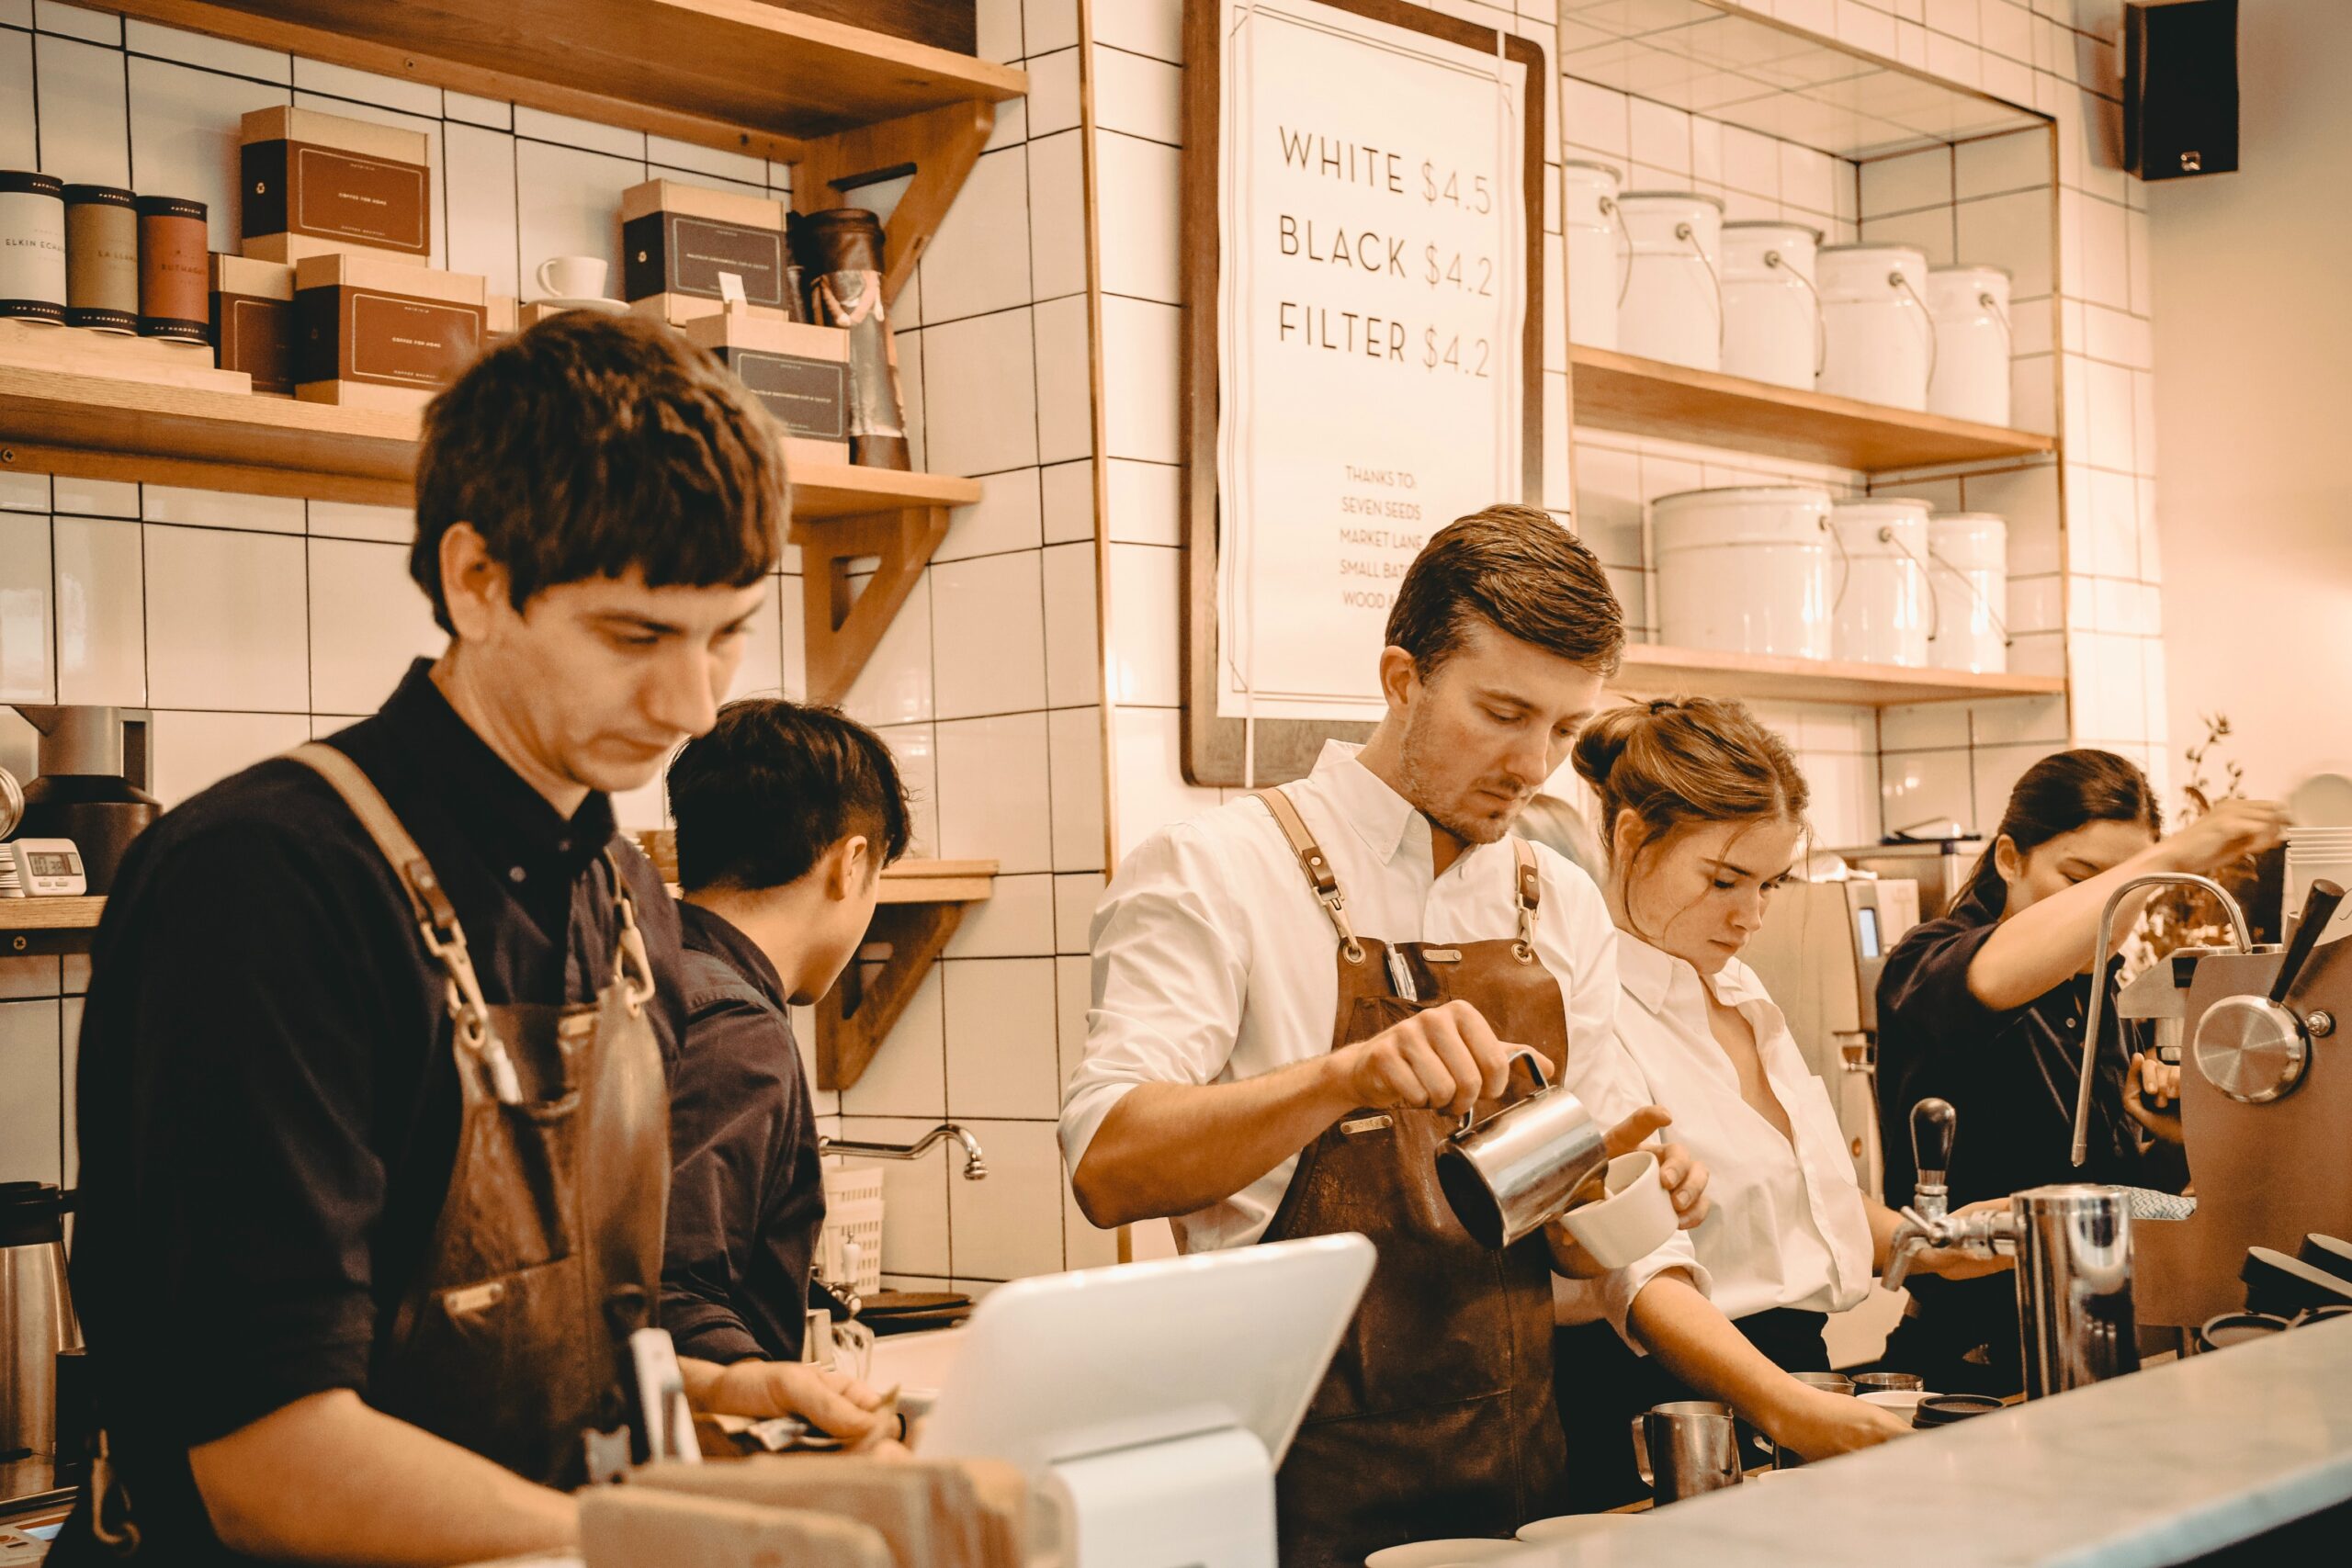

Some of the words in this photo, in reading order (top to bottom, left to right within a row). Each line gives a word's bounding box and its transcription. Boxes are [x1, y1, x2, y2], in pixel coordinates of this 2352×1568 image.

[1279, 125, 1404, 194] WHITE
[1420, 157, 1492, 216] $4.5
[5, 238, 37, 247] ELKIN
[1279, 214, 1407, 278] BLACK
[1424, 241, 1493, 297] $4.2
[1279, 301, 1406, 363] FILTER
[1422, 323, 1490, 378] $4.2
[1345, 465, 1394, 487] THANKS
[1341, 496, 1382, 515] SEVEN
[1385, 501, 1421, 521] SEEDS
[1340, 528, 1389, 547] MARKET
[1393, 534, 1423, 550] LANE
[1340, 558, 1380, 578] SMALL
[1383, 561, 1408, 579] BAT
[1342, 591, 1385, 609] WOOD
